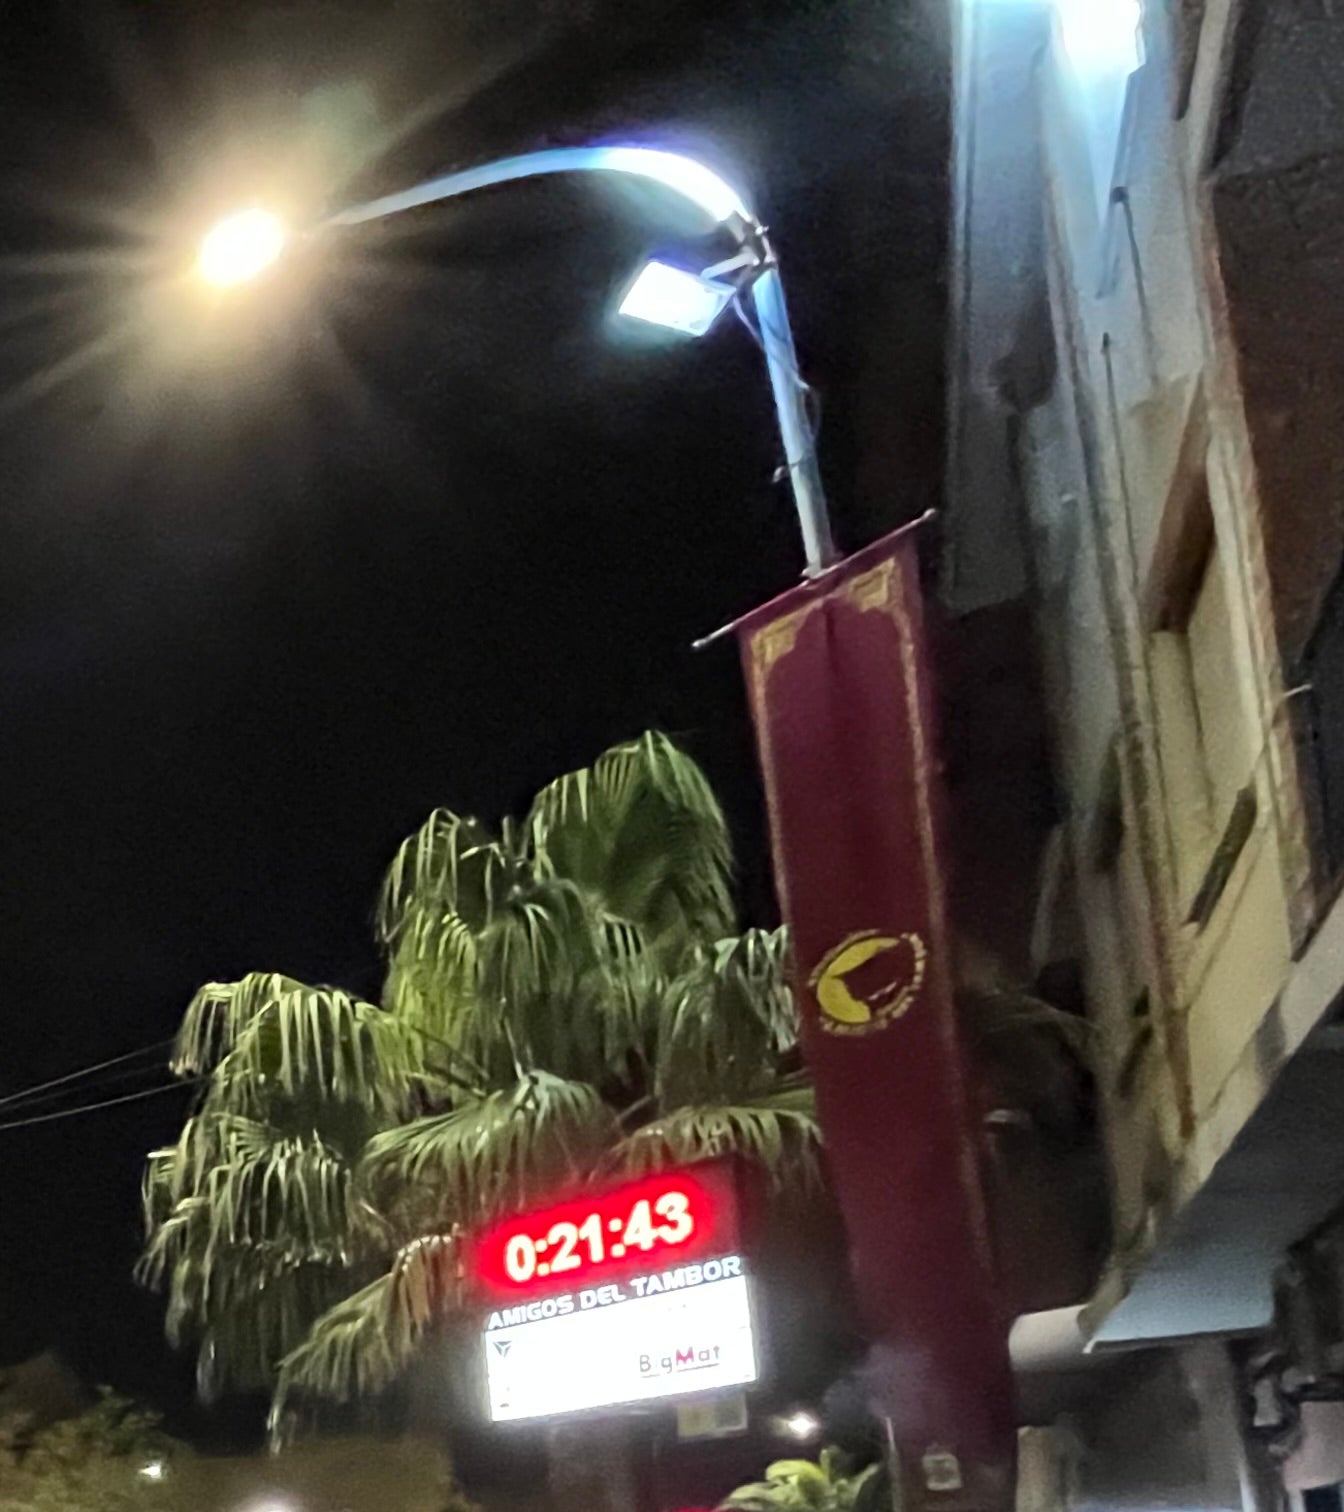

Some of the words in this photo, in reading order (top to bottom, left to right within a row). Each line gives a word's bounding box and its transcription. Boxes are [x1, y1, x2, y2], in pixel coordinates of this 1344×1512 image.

[504, 1191, 695, 1282] 0:21:43
[487, 1295, 575, 1330] AMIGOS
[579, 1284, 627, 1311] DEL
[630, 1255, 742, 1297] TAMBOR
[638, 1345, 721, 1374] BgMat
